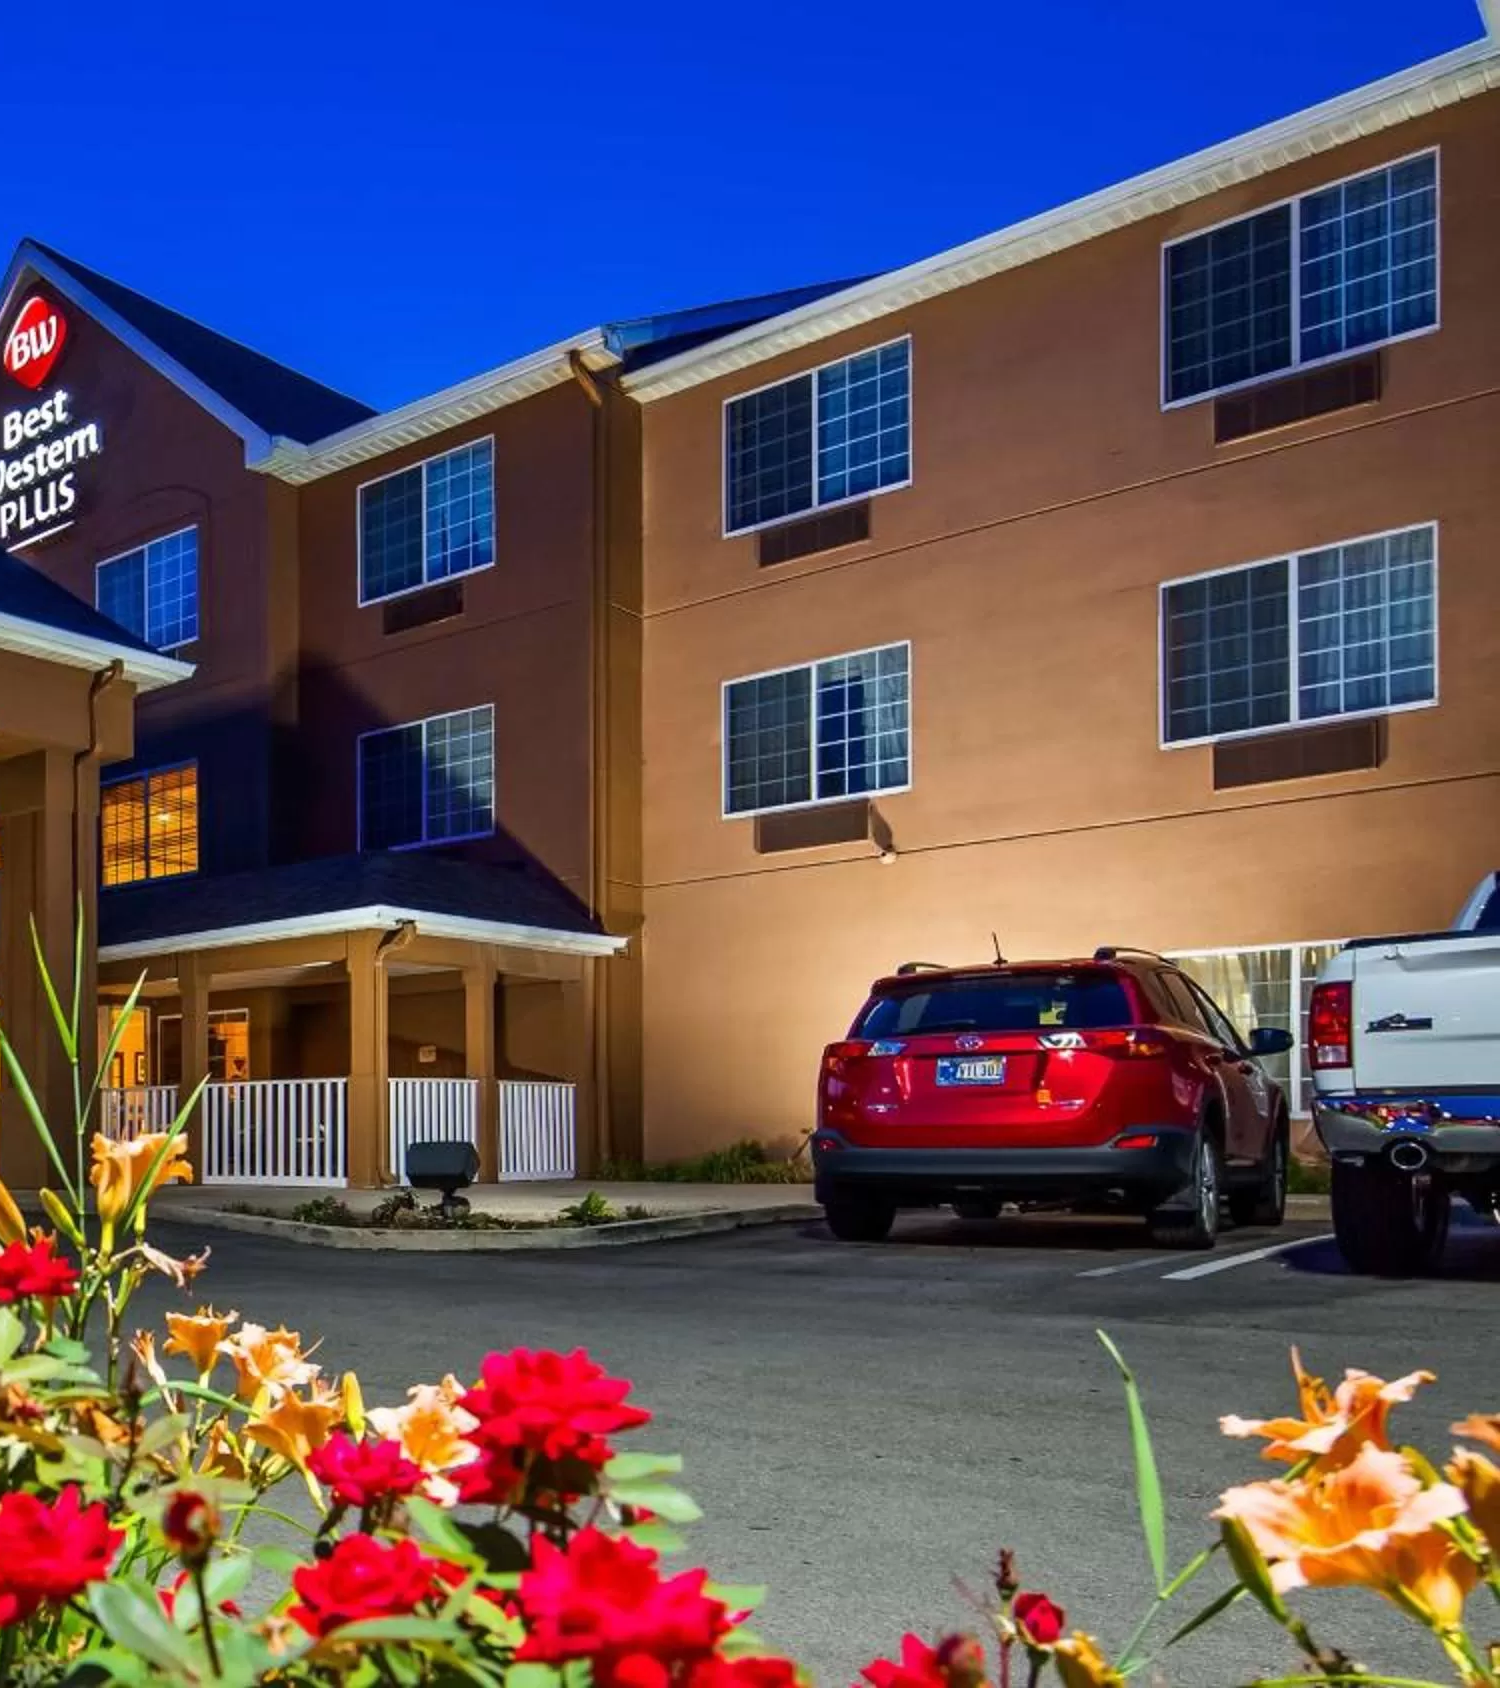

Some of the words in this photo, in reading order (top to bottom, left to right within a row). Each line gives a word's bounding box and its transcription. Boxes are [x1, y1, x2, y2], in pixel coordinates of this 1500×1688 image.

[10, 315, 57, 371] BW
[3, 389, 68, 450] Best
[0, 472, 75, 538] PLUS
